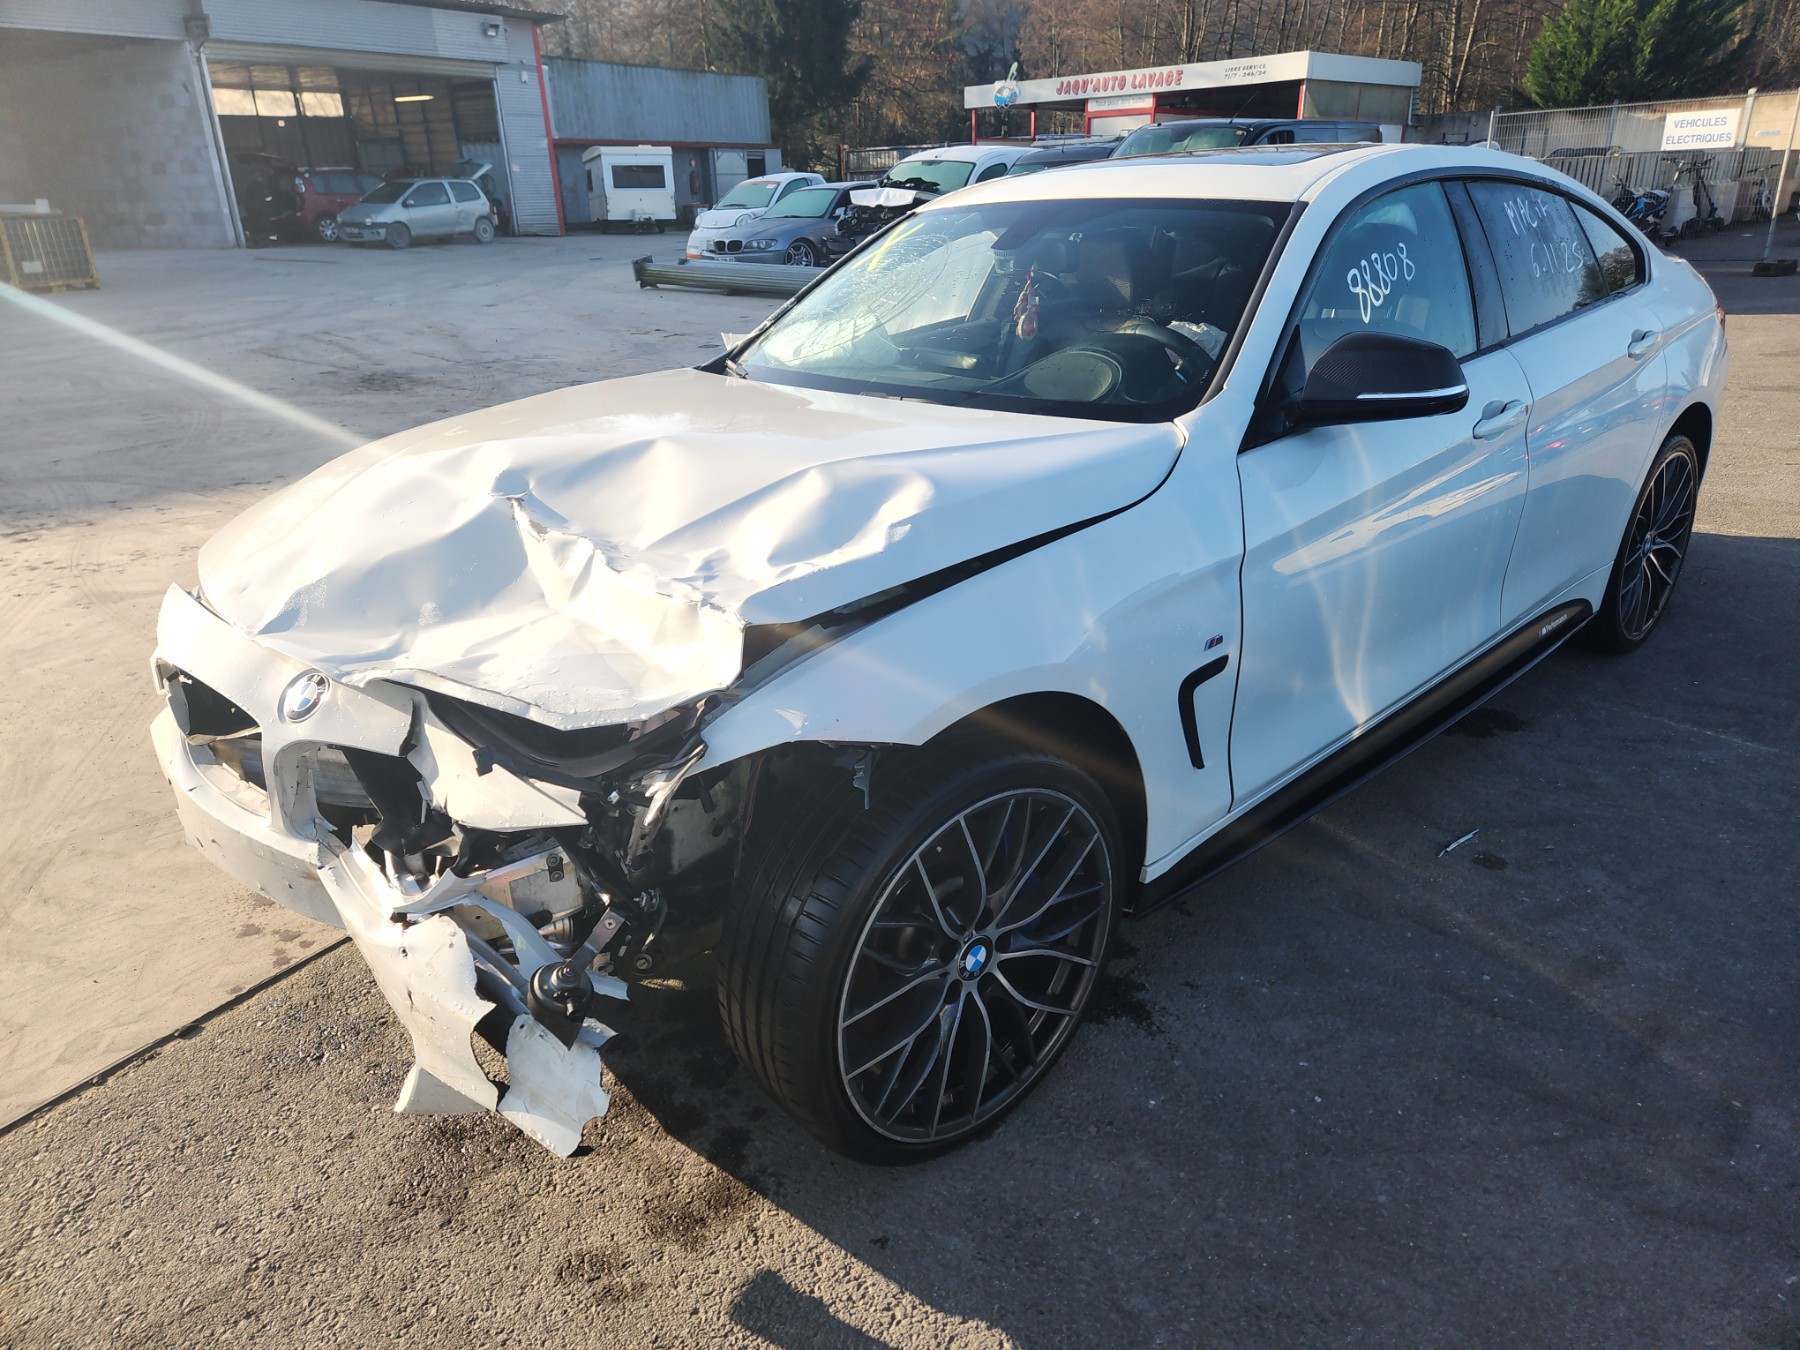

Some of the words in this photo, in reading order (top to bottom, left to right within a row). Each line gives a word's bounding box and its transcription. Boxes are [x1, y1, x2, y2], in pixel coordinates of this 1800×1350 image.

[1056, 77, 1126, 95] JAQU'AUTO
[1131, 69, 1183, 89] LAVAGE
[1665, 132, 1732, 145] ÉLECTRIQUES
[1347, 242, 1416, 324] 88808
